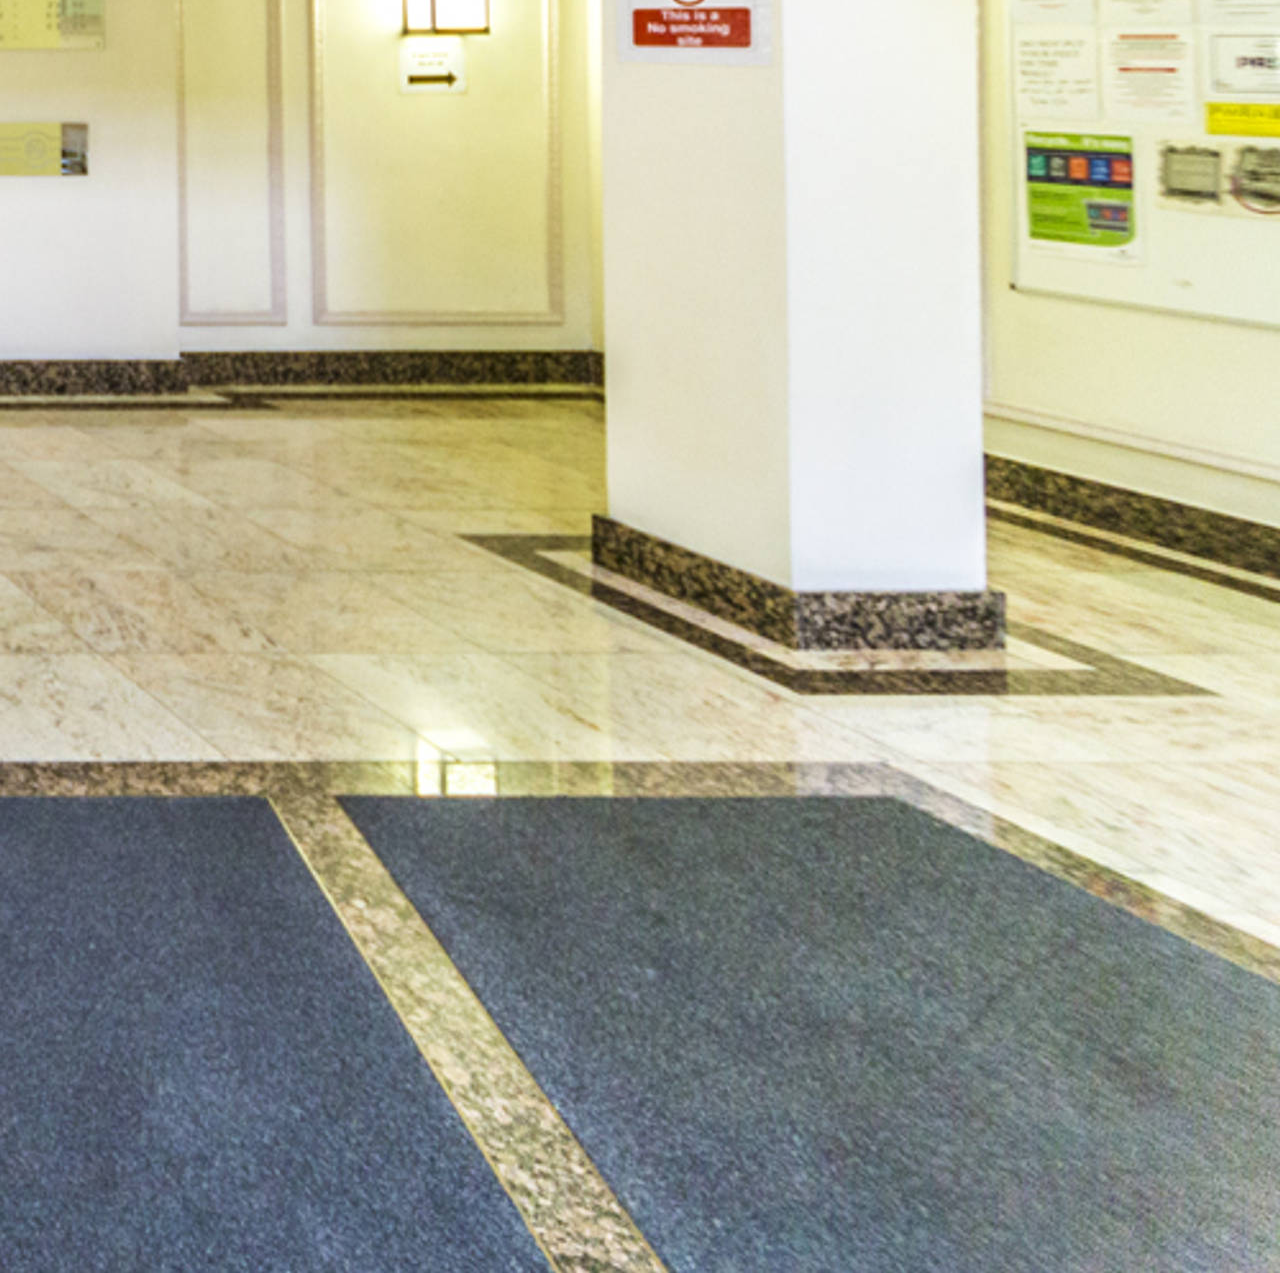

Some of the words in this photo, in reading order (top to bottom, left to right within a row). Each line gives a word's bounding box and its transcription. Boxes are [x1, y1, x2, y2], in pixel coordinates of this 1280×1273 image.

[662, 10, 690, 21] This
[694, 10, 707, 21] is
[710, 11, 719, 21] a
[647, 22, 666, 33] No
[669, 22, 730, 37] smoking
[676, 35, 703, 46] site
